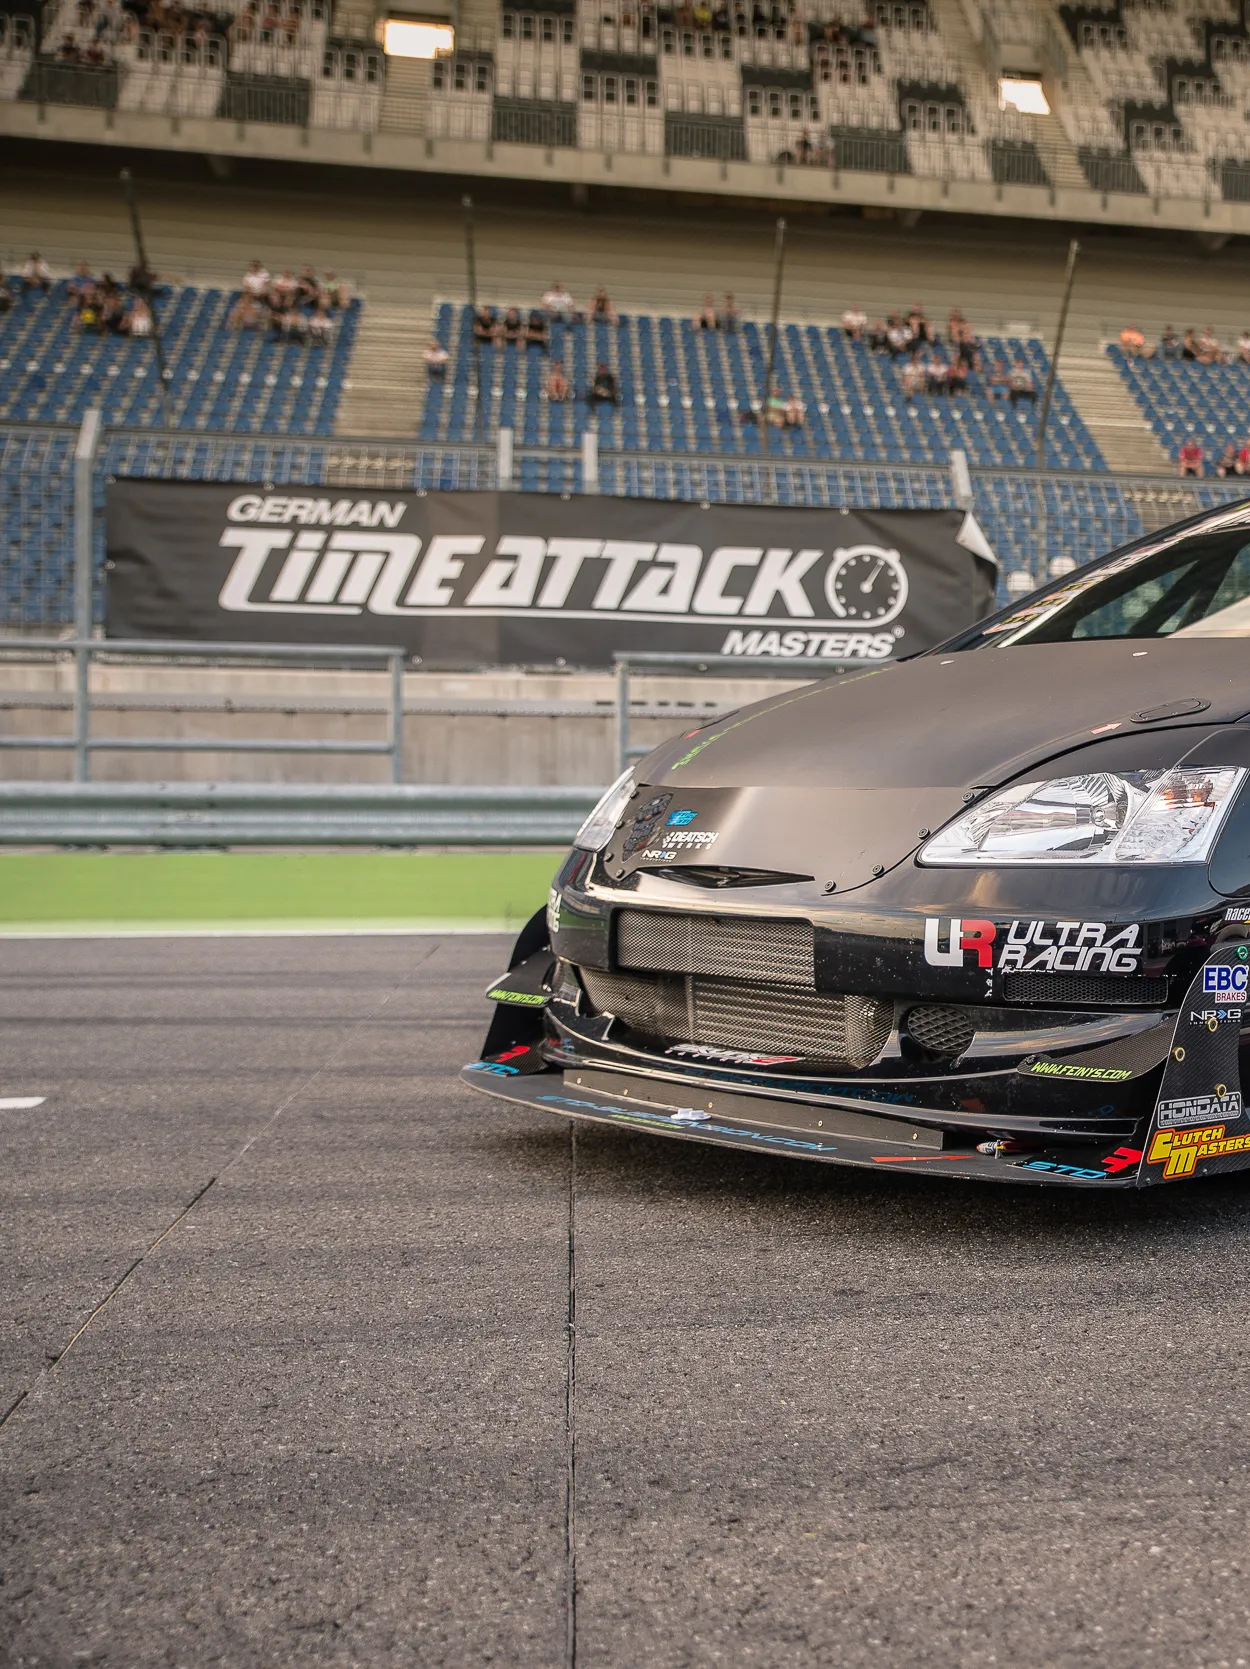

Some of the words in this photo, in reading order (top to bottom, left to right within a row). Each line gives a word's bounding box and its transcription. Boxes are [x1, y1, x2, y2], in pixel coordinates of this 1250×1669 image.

[226, 494, 406, 528] GERMAN
[722, 629, 895, 659] MASTERS
[1006, 920, 1140, 948] ULTRA
[998, 944, 1142, 973] RACING
[1204, 966, 1247, 991] EBC
[1216, 992, 1246, 1001] BRAKES
[1029, 1061, 1133, 1080] WWW.FEINYS.COM
[1160, 1094, 1239, 1120] HONDATA
[1149, 1127, 1224, 1161] CLUTCH
[1023, 1161, 1107, 1179] STD
